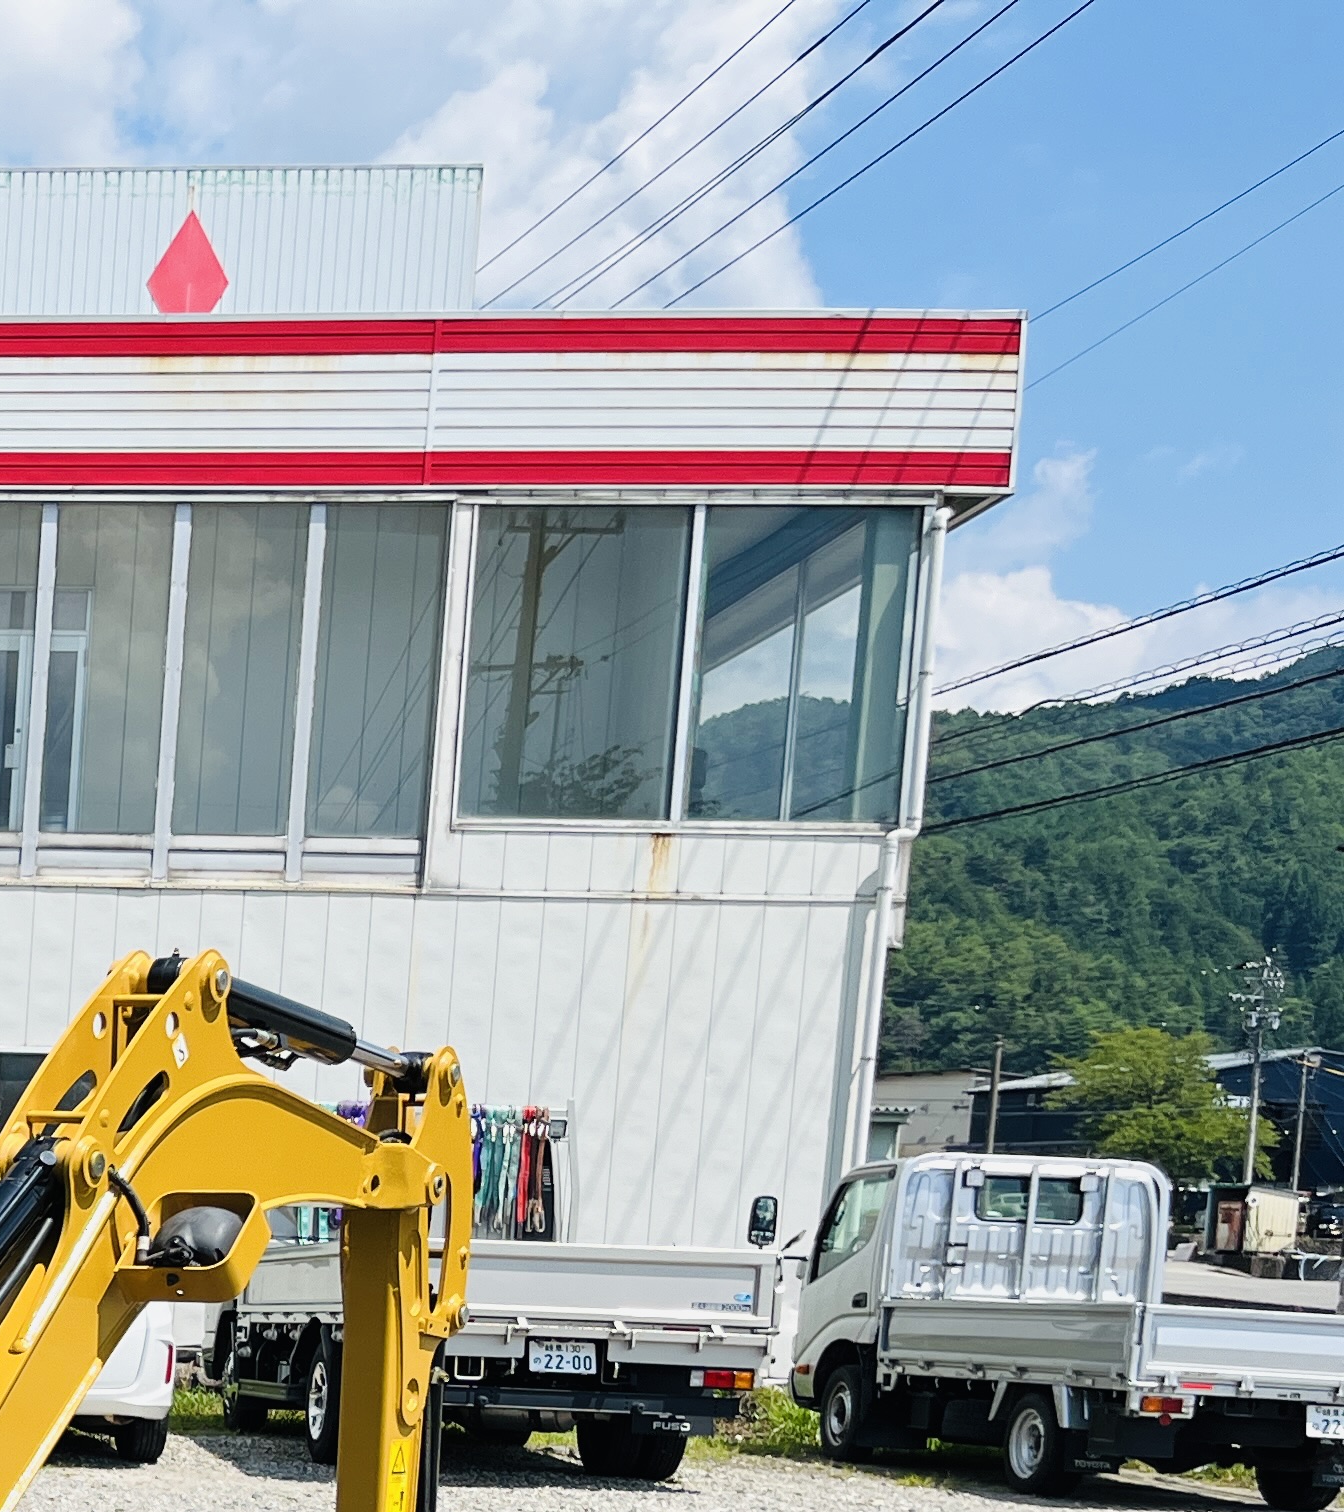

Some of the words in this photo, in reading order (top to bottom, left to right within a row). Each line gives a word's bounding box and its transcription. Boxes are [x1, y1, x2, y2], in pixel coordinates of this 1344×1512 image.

[565, 1344, 581, 1353] 130
[544, 1353, 592, 1371] 22-00
[652, 1421, 691, 1431] FUSO
